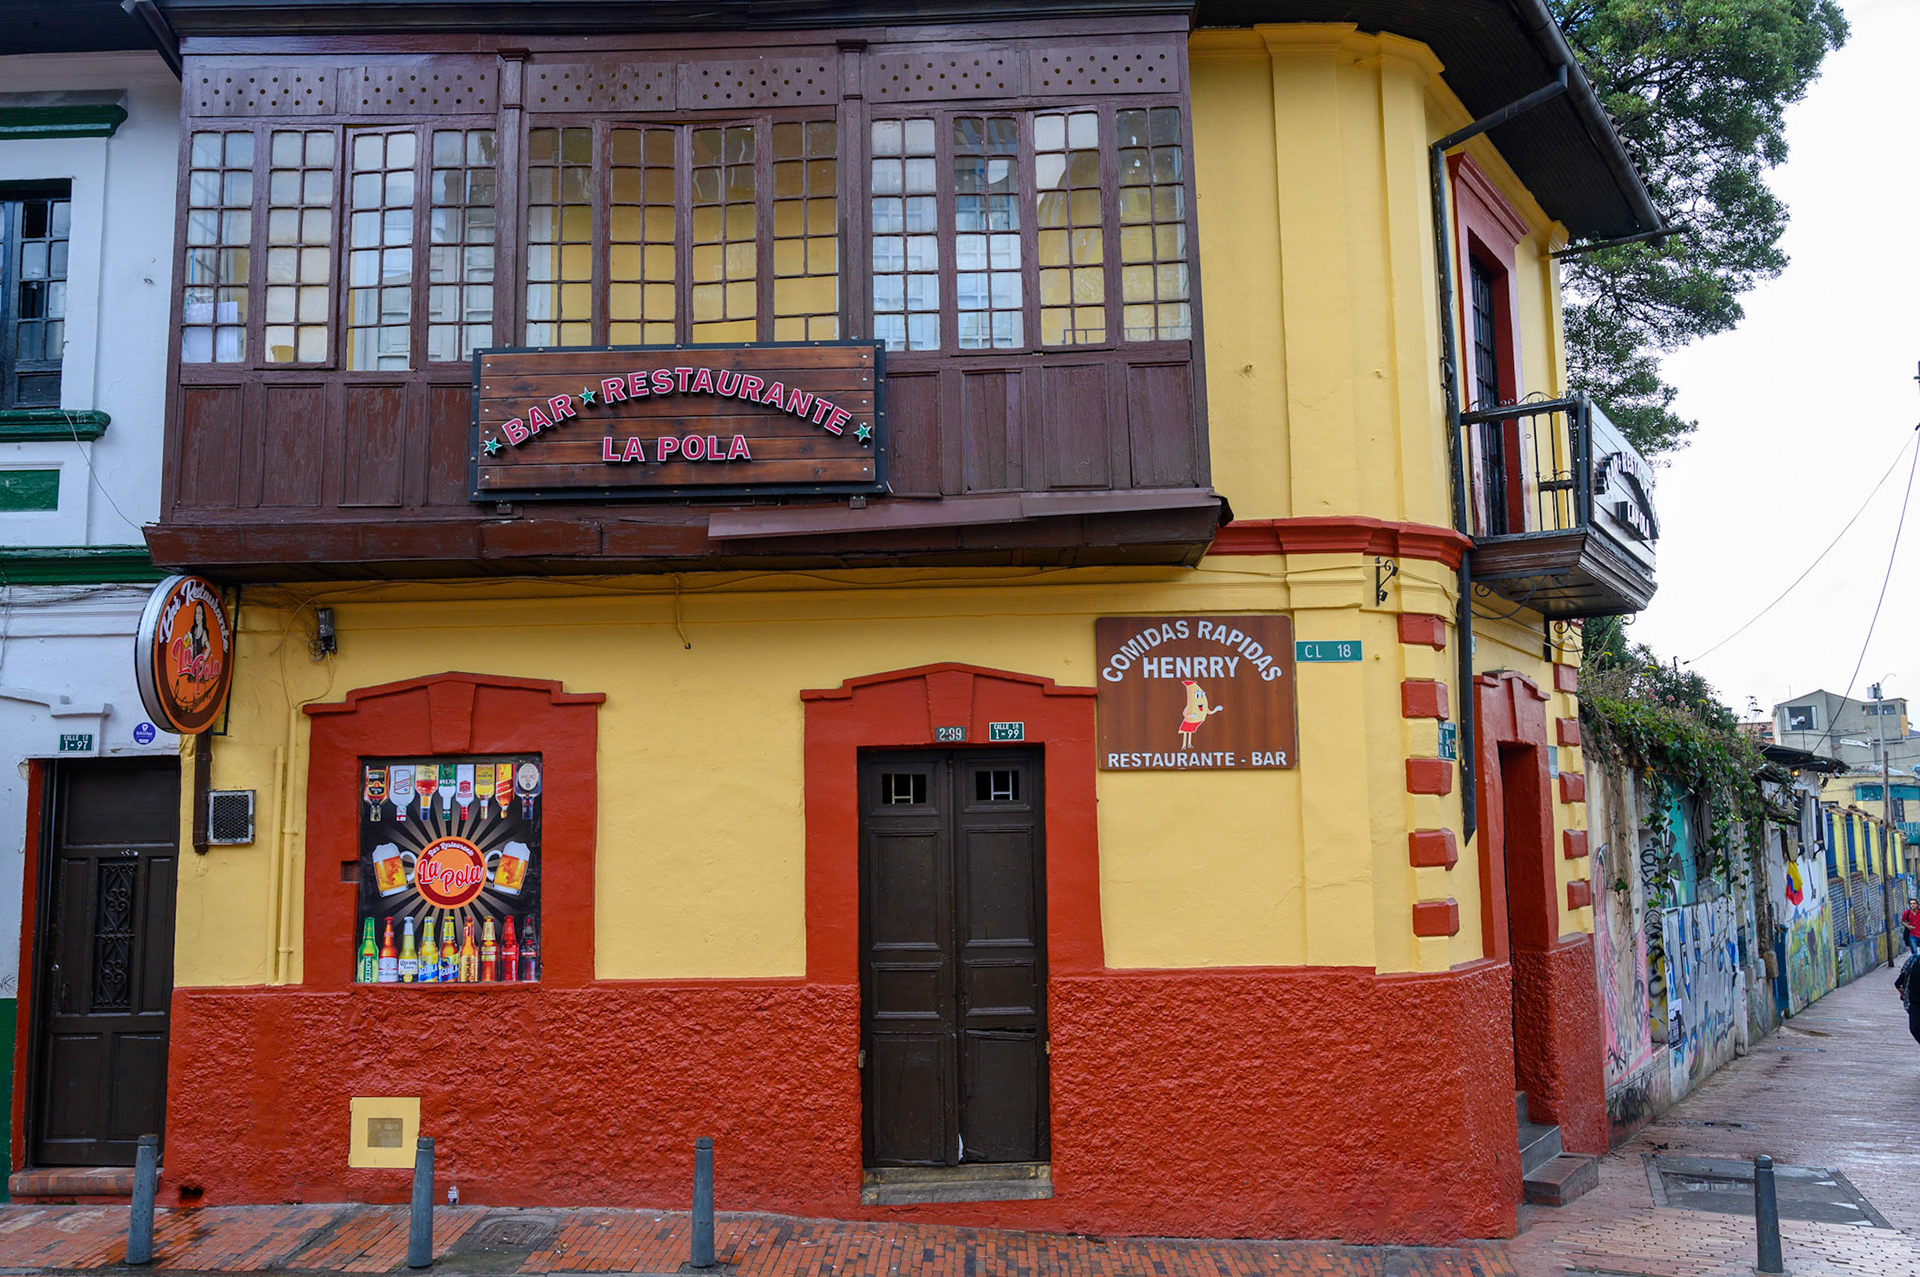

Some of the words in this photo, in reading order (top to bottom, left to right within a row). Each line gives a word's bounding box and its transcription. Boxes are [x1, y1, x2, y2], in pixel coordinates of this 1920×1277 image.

[502, 393, 577, 447] BAR
[601, 366, 853, 437] RESTAURANTE
[602, 436, 645, 462] LA
[657, 434, 751, 462] POLA
[159, 595, 181, 644] Bar
[180, 579, 231, 653] Restaurante
[172, 637, 194, 677] La
[1102, 620, 1190, 682] COMIDAS
[1197, 620, 1283, 682] RAPIDAS
[1305, 645, 1322, 658] CL
[1337, 644, 1352, 658] 18
[191, 653, 222, 694] Pola
[1143, 656, 1240, 679] HENRRY
[65, 741, 88, 751] 1-97
[939, 727, 962, 741] 2-99
[995, 729, 1019, 740] 1-99
[1108, 752, 1235, 768] RESTAURANTE
[1251, 751, 1288, 766] BAR
[418, 858, 442, 885] La
[439, 863, 484, 894] Pola
